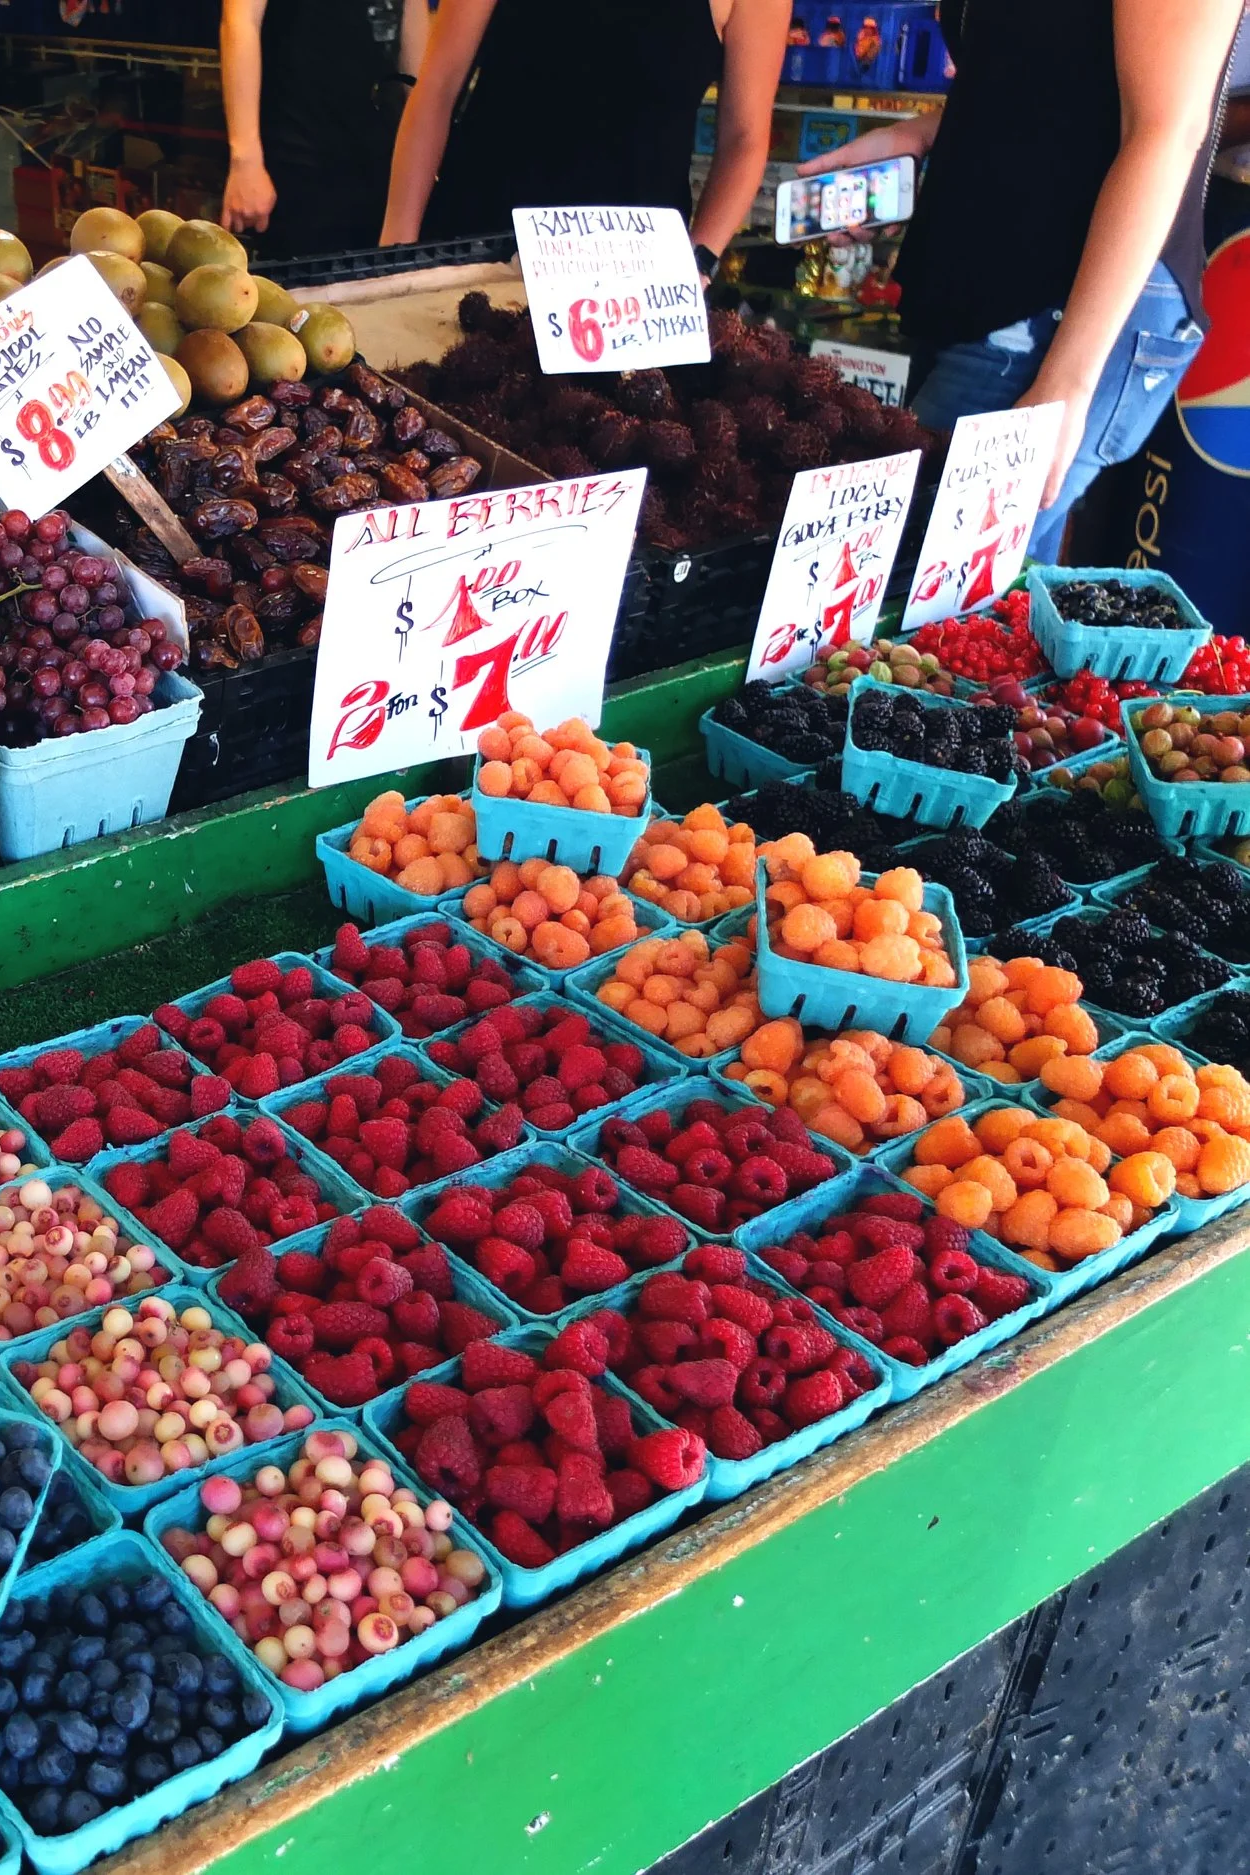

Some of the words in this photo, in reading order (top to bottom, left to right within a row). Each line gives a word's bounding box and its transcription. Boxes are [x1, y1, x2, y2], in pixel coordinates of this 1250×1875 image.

[643, 283, 698, 309] HAIRY
[67, 315, 102, 352] NO
[79, 323, 131, 377] SAMPLE
[101, 346, 125, 378] AND
[106, 345, 152, 398] MEAN
[73, 410, 101, 439] LB
[344, 506, 430, 553] ALL
[446, 480, 634, 539] BERRIES
[491, 580, 550, 612] BOX
[327, 680, 390, 761] 2
